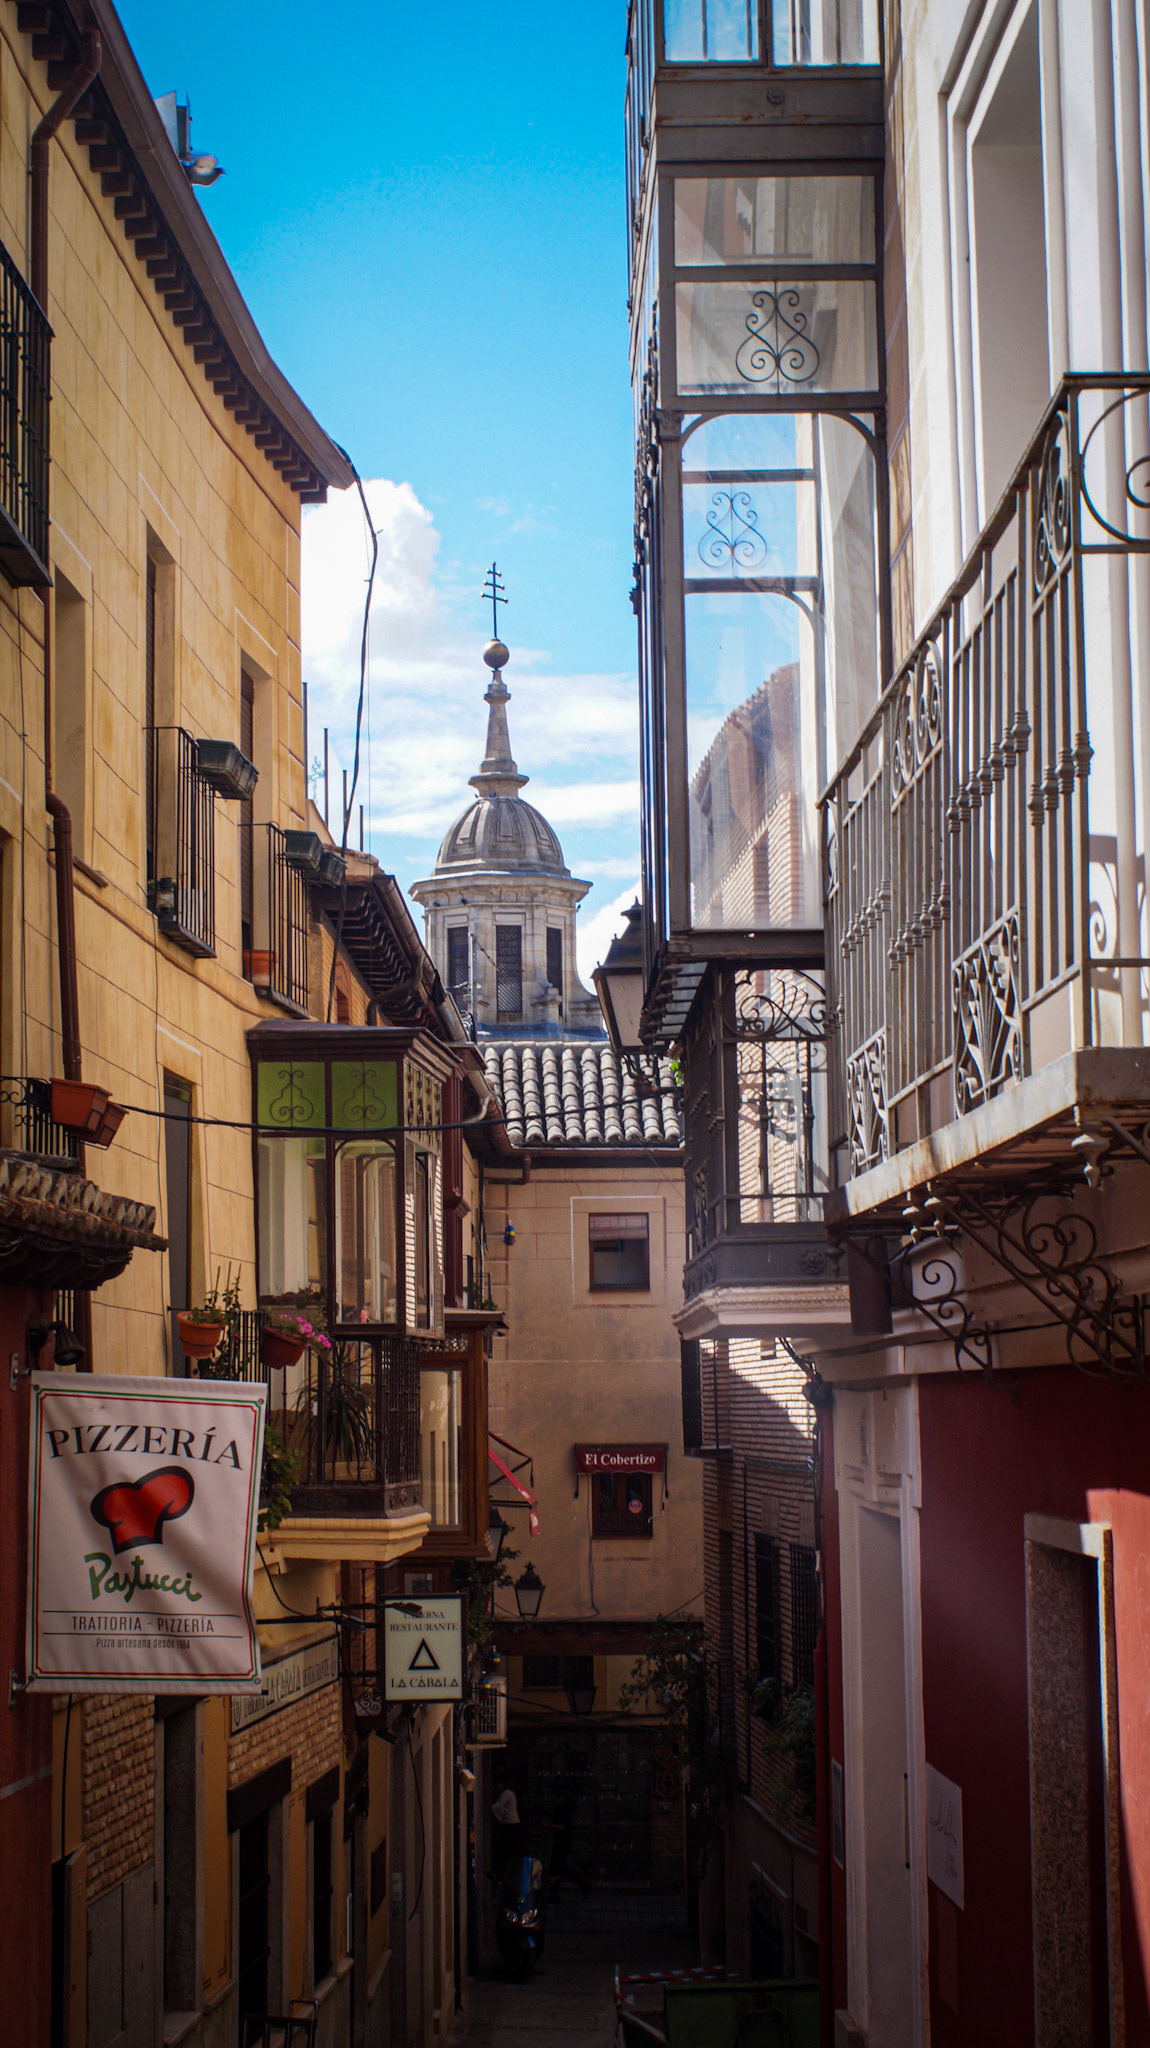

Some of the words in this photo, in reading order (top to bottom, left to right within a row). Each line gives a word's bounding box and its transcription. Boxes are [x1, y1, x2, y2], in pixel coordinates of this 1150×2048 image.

[46, 1425, 243, 1470] PIZZERÍA
[585, 1453, 598, 1465] El
[600, 1453, 656, 1466] Cobertizo
[84, 1552, 203, 1603] Pastucci
[72, 1616, 142, 1632] TRATTORIA
[157, 1617, 214, 1633] PIZZERÍA
[390, 1623, 458, 1632] RESTAURANTE
[96, 1637, 115, 1648] Pizza
[117, 1638, 151, 1649] artesana
[153, 1638, 175, 1649] desde
[391, 1678, 407, 1688] LA
[266, 1677, 275, 1706] LA
